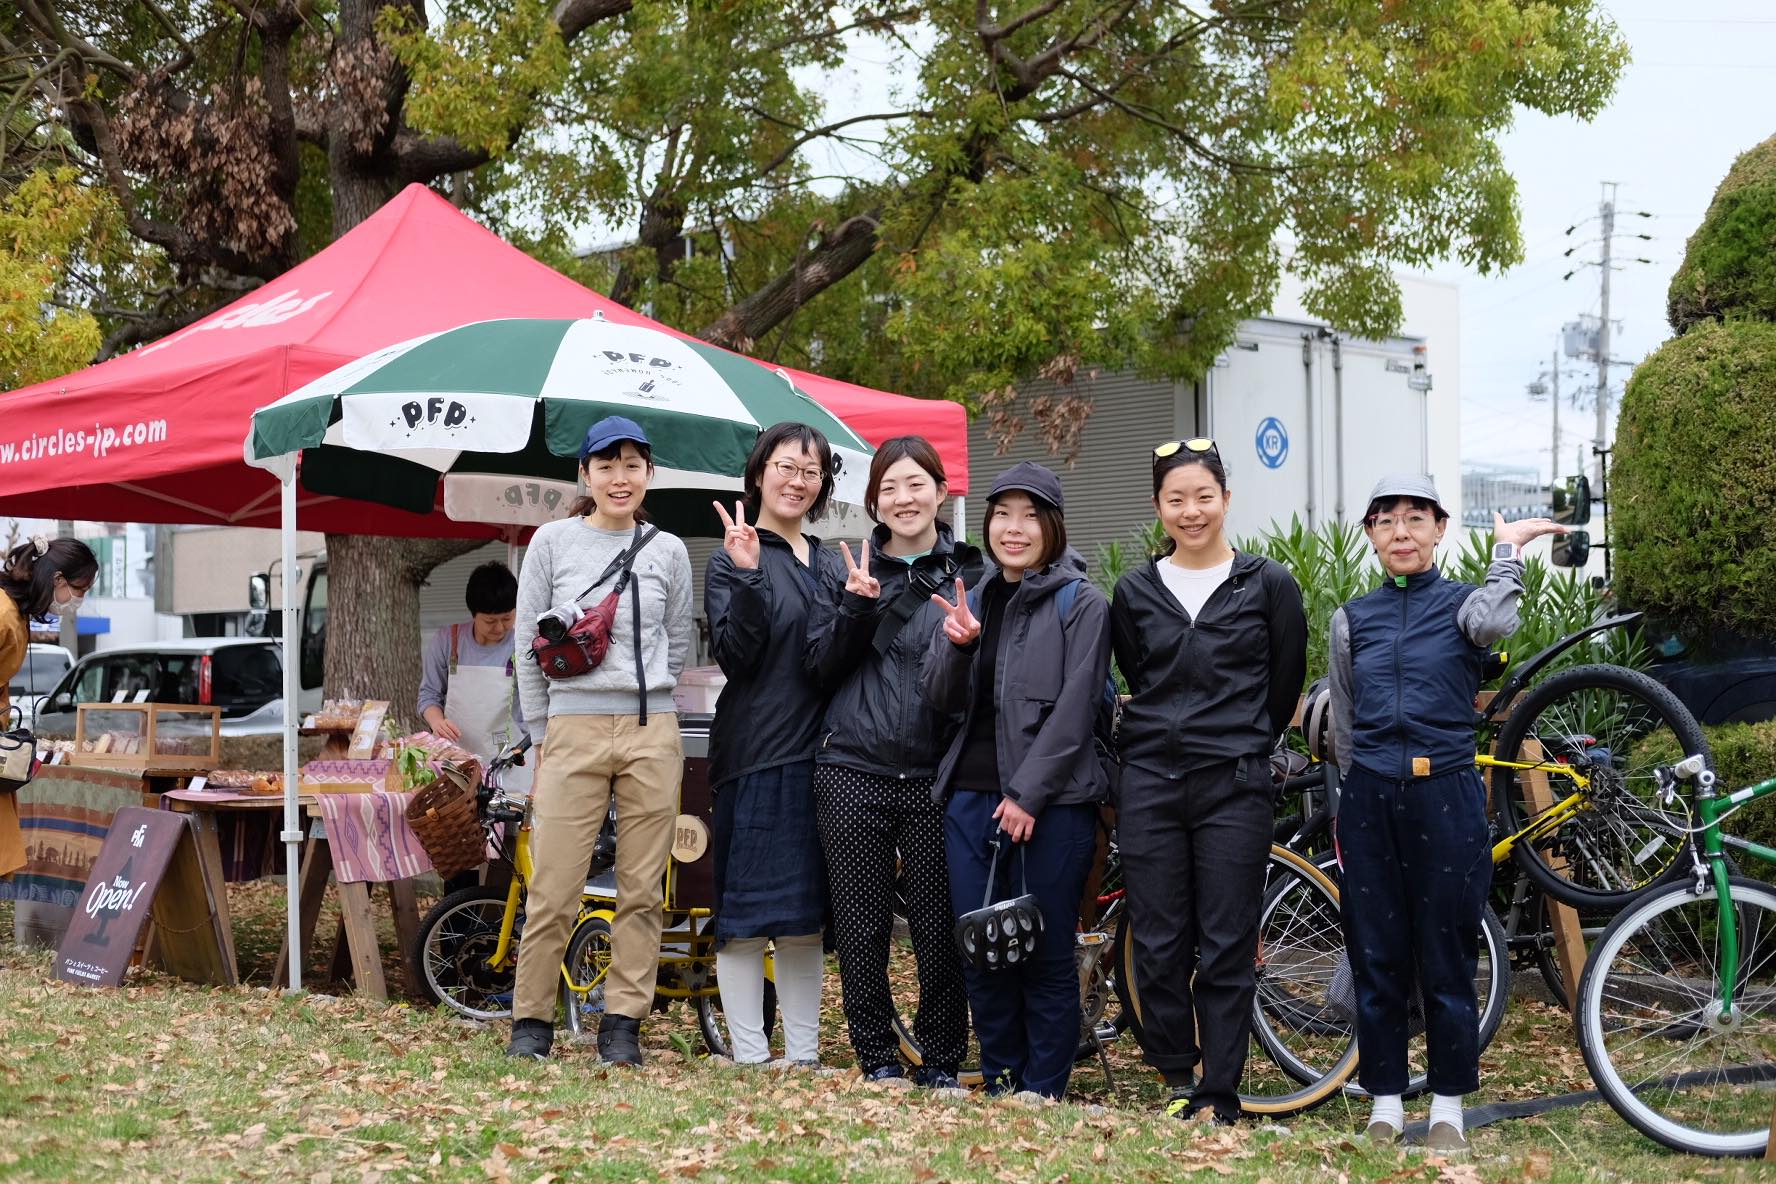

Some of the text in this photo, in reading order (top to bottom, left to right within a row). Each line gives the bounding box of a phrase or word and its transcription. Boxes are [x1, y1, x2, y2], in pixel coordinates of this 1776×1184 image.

[402, 397, 467, 429] PFP
[113, 875, 130, 888] Now
[86, 881, 147, 919] Open!
